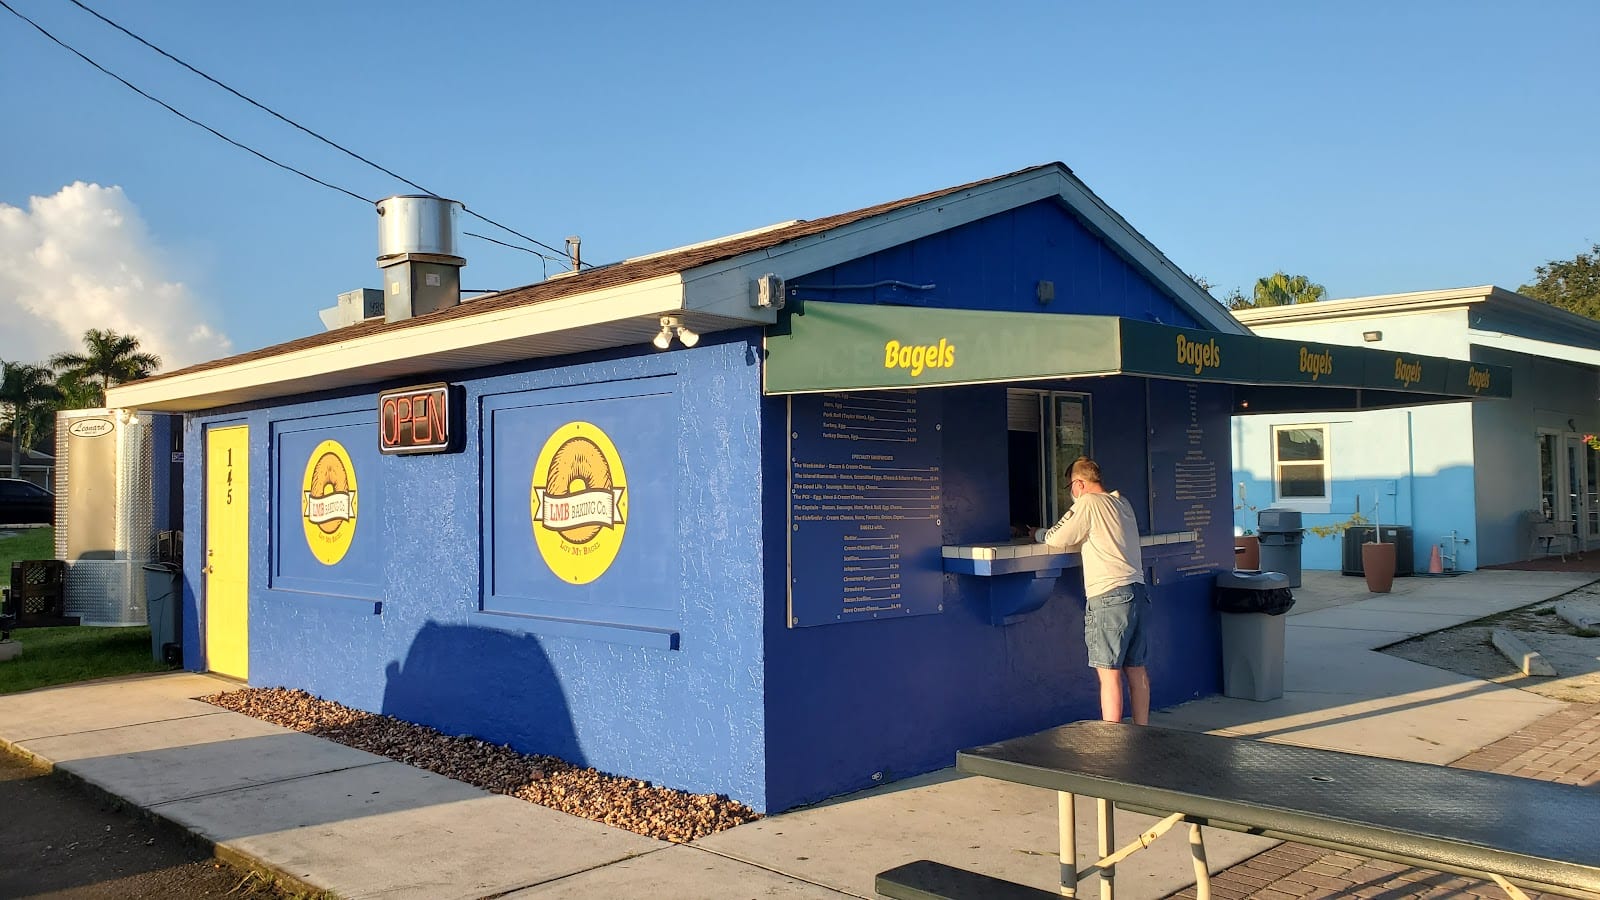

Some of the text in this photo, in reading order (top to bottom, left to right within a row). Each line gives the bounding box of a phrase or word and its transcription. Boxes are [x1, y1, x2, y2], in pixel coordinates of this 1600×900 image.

[884, 337, 956, 377] Bagels
[1176, 333, 1221, 375] Bagels
[1299, 346, 1333, 381] Bagels
[1394, 357, 1422, 388] Bagels
[1467, 366, 1491, 393] Bagels
[383, 394, 445, 445] OPEN
[312, 502, 325, 517] LMB
[549, 503, 570, 521] LMB
[571, 501, 596, 519] BAKING
